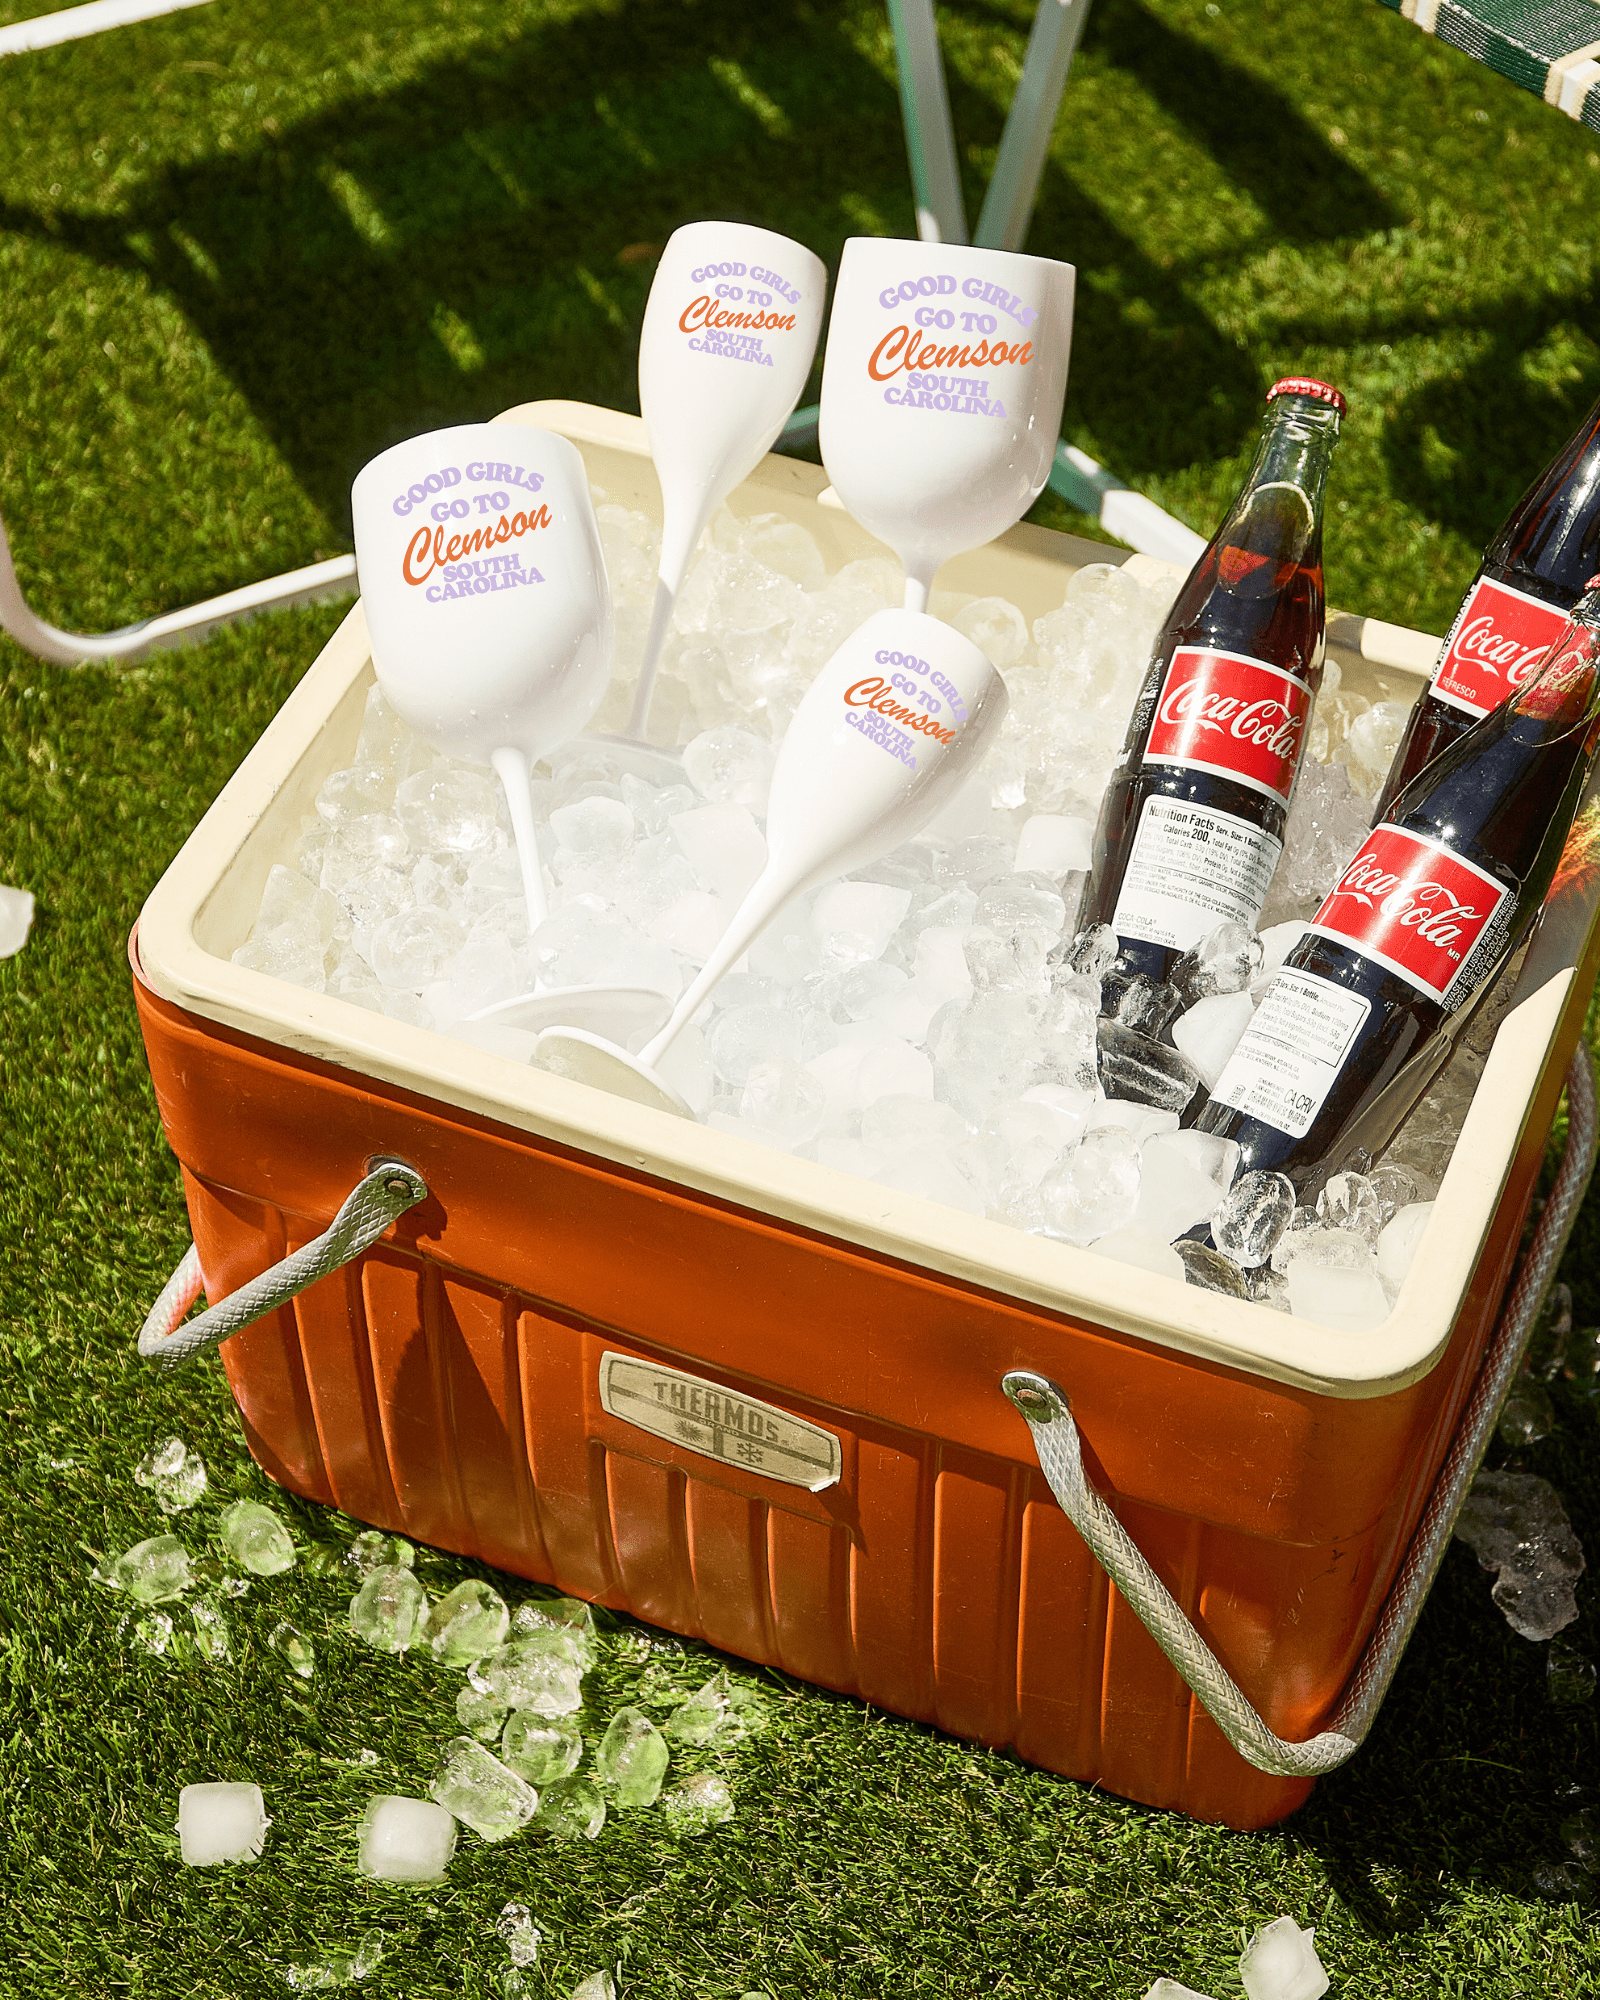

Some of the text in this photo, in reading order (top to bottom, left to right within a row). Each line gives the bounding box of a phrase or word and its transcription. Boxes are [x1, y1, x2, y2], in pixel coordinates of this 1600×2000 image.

[691, 262, 802, 304] GOOD GIRLS
[715, 284, 773, 307] GO TO
[879, 275, 1038, 327] GOOD GIRLS
[679, 296, 796, 333] Clemson
[915, 307, 997, 335] GO TO
[688, 338, 774, 366] CAROLINA
[705, 329, 763, 352] SOUTH
[868, 325, 1034, 381] Clemson
[884, 387, 1007, 418] CAROLINA
[907, 372, 989, 398] SOUTH
[393, 462, 544, 516] GOOD GIRLS
[431, 491, 510, 522] GO TO
[403, 504, 552, 586] Clemson
[426, 567, 545, 603] CAROLINA
[443, 553, 521, 583] SOUTH
[875, 650, 968, 722] GOOD GIRLS
[891, 673, 941, 713] GO TO
[1442, 676, 1476, 699] REFRESCO
[844, 677, 955, 744] Clemson
[1160, 677, 1302, 759] Coca-Cola
[845, 712, 916, 770] CAROLINA
[864, 710, 916, 756] SOUTH
[1149, 805, 1188, 823] Nutrition
[1189, 814, 1215, 830] Facts
[1216, 825, 1229, 836] Serv.
[1230, 831, 1243, 842] Size:
[1244, 836, 1248, 844] 1
[1163, 823, 1190, 837] Calories
[1191, 828, 1210, 845] 200,
[1212, 838, 1225, 848] Total
[1225, 842, 1233, 851] Fat
[1166, 836, 1180, 845] Total
[1204, 857, 1221, 869] Protein
[1333, 853, 1482, 947] Coca-Cola
[1440, 890, 1518, 1010] ENVASE EXCLUSIVO PARA REFRESCO
[1447, 948, 1461, 961] MR
[1471, 932, 1502, 973] COCA-COLA
[1464, 970, 1479, 988] THE
[1470, 967, 1489, 992] HECHO
[1484, 956, 1495, 968] EN
[1303, 988, 1319, 1002] Bottle,
[1311, 1007, 1331, 1022] Sodium
[1331, 1017, 1349, 1031] 120mg
[1329, 1028, 1341, 1040] 53g
[1283, 1088, 1298, 1106] CA
[1295, 1094, 1317, 1114] CRV
[654, 1382, 779, 1445] THERMOS
